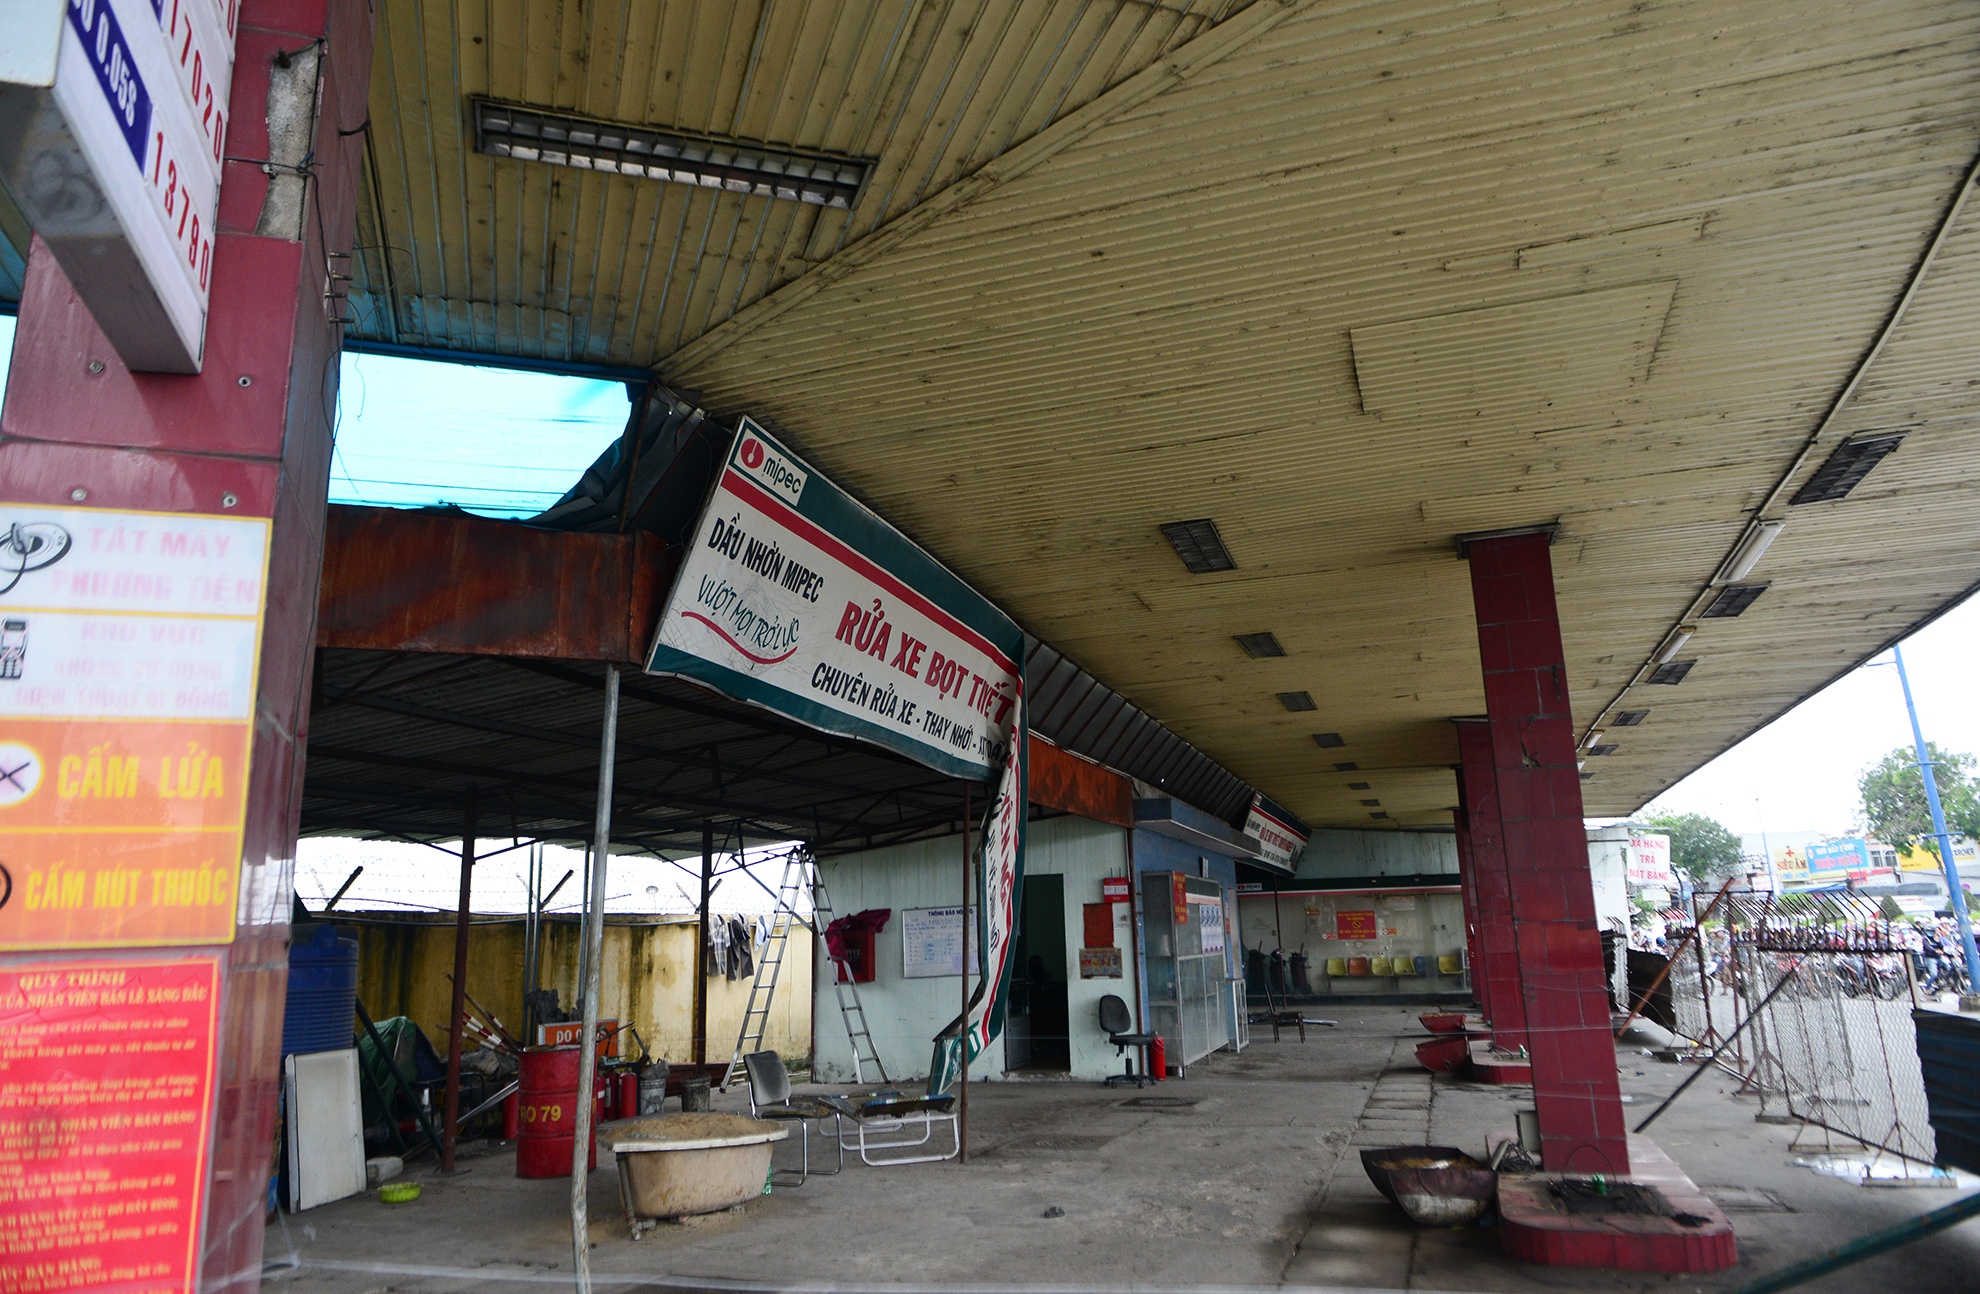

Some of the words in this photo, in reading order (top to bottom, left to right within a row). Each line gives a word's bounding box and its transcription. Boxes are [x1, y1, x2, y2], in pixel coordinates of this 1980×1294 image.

[763, 456, 802, 495] mipec
[160, 525, 232, 559] MÁY
[707, 512, 746, 560] DẦU
[741, 540, 785, 583] NHỜN
[781, 559, 824, 603] MIPEC
[697, 573, 737, 616] VƯỢT
[734, 599, 756, 637] MỌI
[751, 615, 778, 648] TRỞ
[773, 617, 799, 653] LỰC
[835, 598, 893, 662] RỬA
[890, 631, 927, 679] XE
[924, 650, 969, 700] BỌT
[811, 662, 872, 707] CHUYÊN
[869, 683, 898, 719] RỬA
[896, 699, 916, 725] XE
[922, 710, 952, 741] THAY
[57, 741, 140, 799] CẤM
[159, 741, 224, 799] LỬA
[25, 859, 86, 912] CẤM
[93, 863, 142, 909] HÚT
[151, 858, 228, 908] THUỐC
[556, 1029, 572, 1043] DO
[541, 1105, 562, 1122] 79
